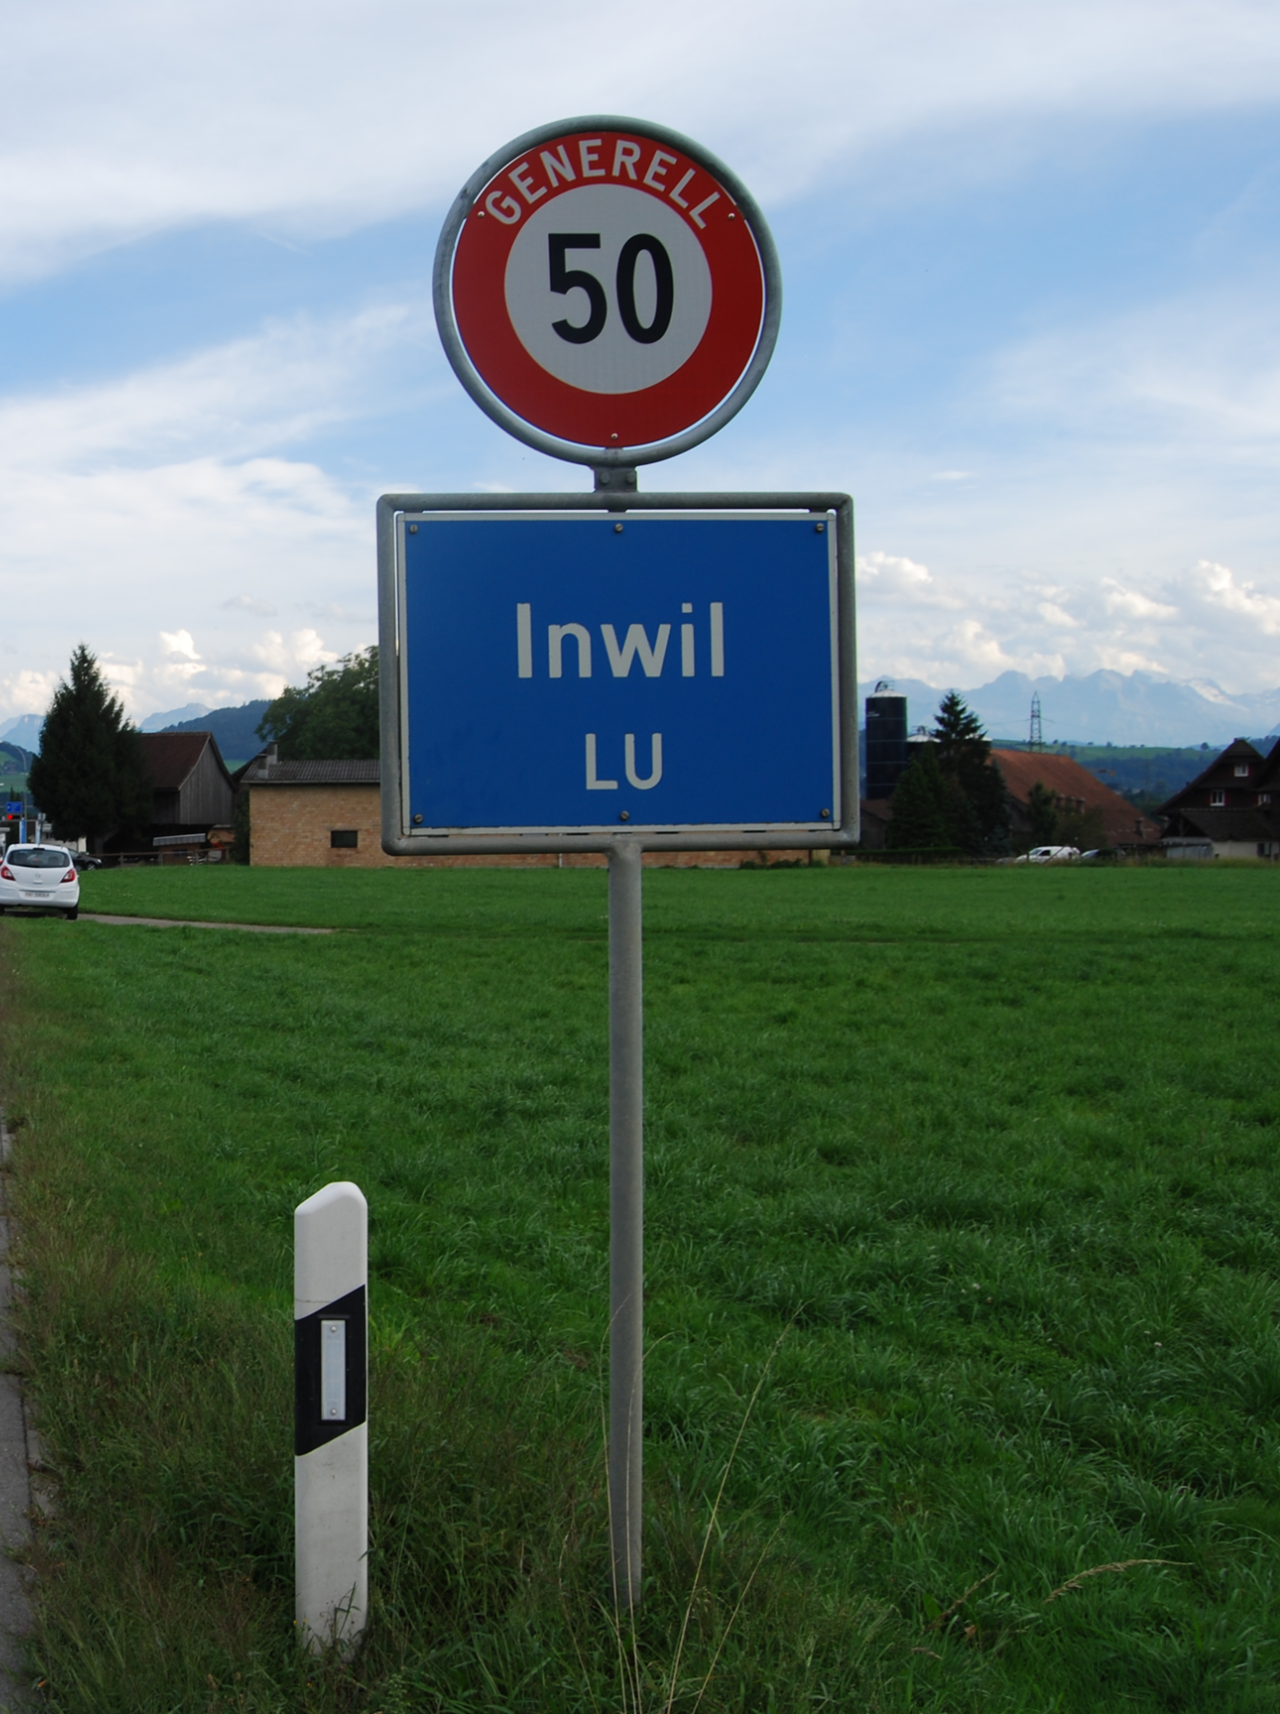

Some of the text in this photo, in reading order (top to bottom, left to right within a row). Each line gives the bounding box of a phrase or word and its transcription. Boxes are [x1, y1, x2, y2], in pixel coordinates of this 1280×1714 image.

[484, 138, 721, 230] GENERELL
[547, 232, 674, 345] 50
[516, 601, 725, 679] Inwil
[585, 732, 663, 791] LU
